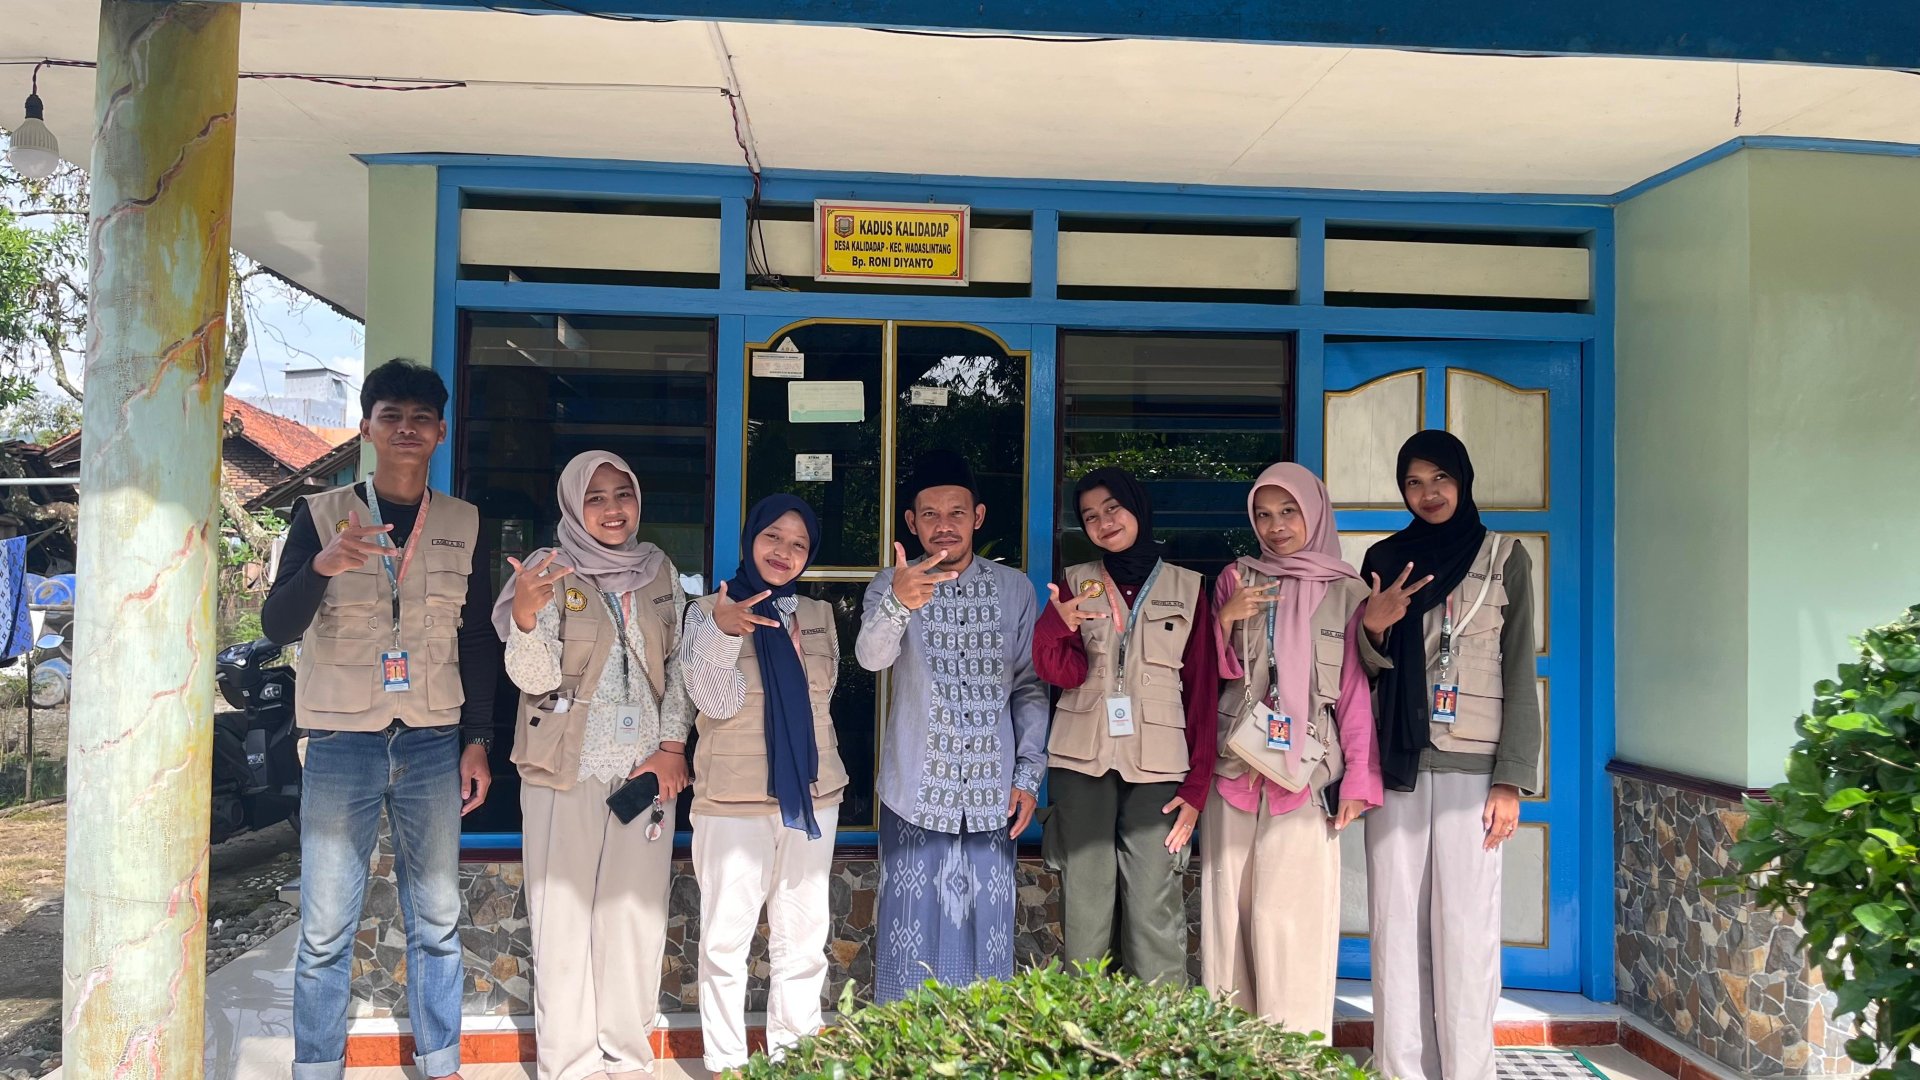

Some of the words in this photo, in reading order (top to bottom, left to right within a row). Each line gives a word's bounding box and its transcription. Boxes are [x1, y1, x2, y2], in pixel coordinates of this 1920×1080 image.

[859, 220, 892, 236] KADUS
[895, 221, 949, 238] KALIDADAP
[834, 240, 850, 250] DESA
[851, 241, 885, 252] KALIDADAP
[889, 242, 904, 253] KEC.
[905, 243, 952, 255] WADASLINTANG
[852, 256, 866, 269] Bp.
[869, 256, 891, 268] RONI
[894, 257, 934, 269] DIYANTO
